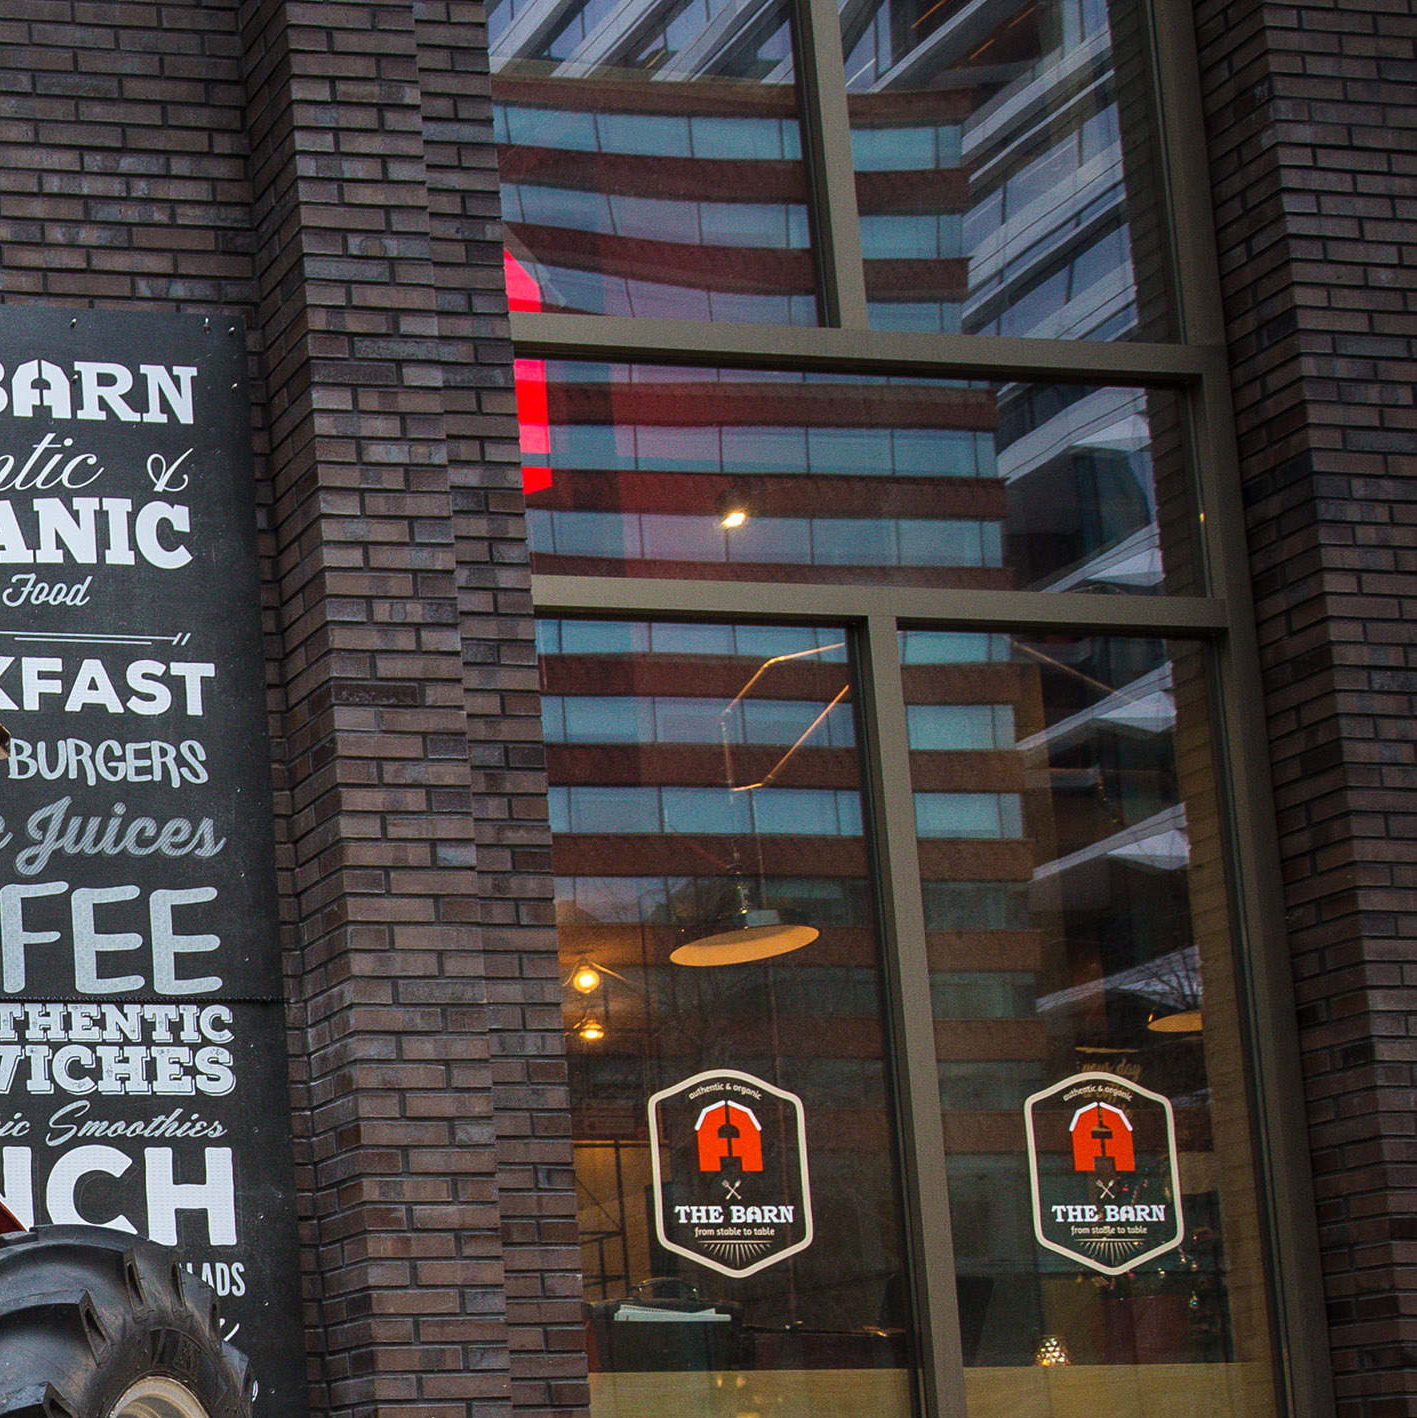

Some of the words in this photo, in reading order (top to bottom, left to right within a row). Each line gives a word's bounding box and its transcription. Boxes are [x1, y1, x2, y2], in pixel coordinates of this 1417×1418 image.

[2, 573, 93, 607] Food
[7, 737, 210, 787] BURGERS
[16, 795, 227, 877] Juices
[0, 880, 224, 997] FEE
[688, 1082, 724, 1100] authentic
[733, 1084, 763, 1101] organic
[1062, 1084, 1097, 1101] authentic
[1105, 1086, 1133, 1102] organic
[45, 1099, 228, 1147] Smoothies
[674, 1205, 724, 1223] THE
[730, 1205, 794, 1223] BARN
[1051, 1205, 1099, 1222] THE
[1104, 1204, 1166, 1222] BARN
[694, 1226, 715, 1238] from
[716, 1226, 742, 1236] stable
[743, 1228, 753, 1236] to
[753, 1226, 776, 1236] table
[1071, 1225, 1090, 1236] from
[1117, 1226, 1126, 1234] to
[1127, 1225, 1148, 1235] table
[179, 1262, 246, 1297] ADS
